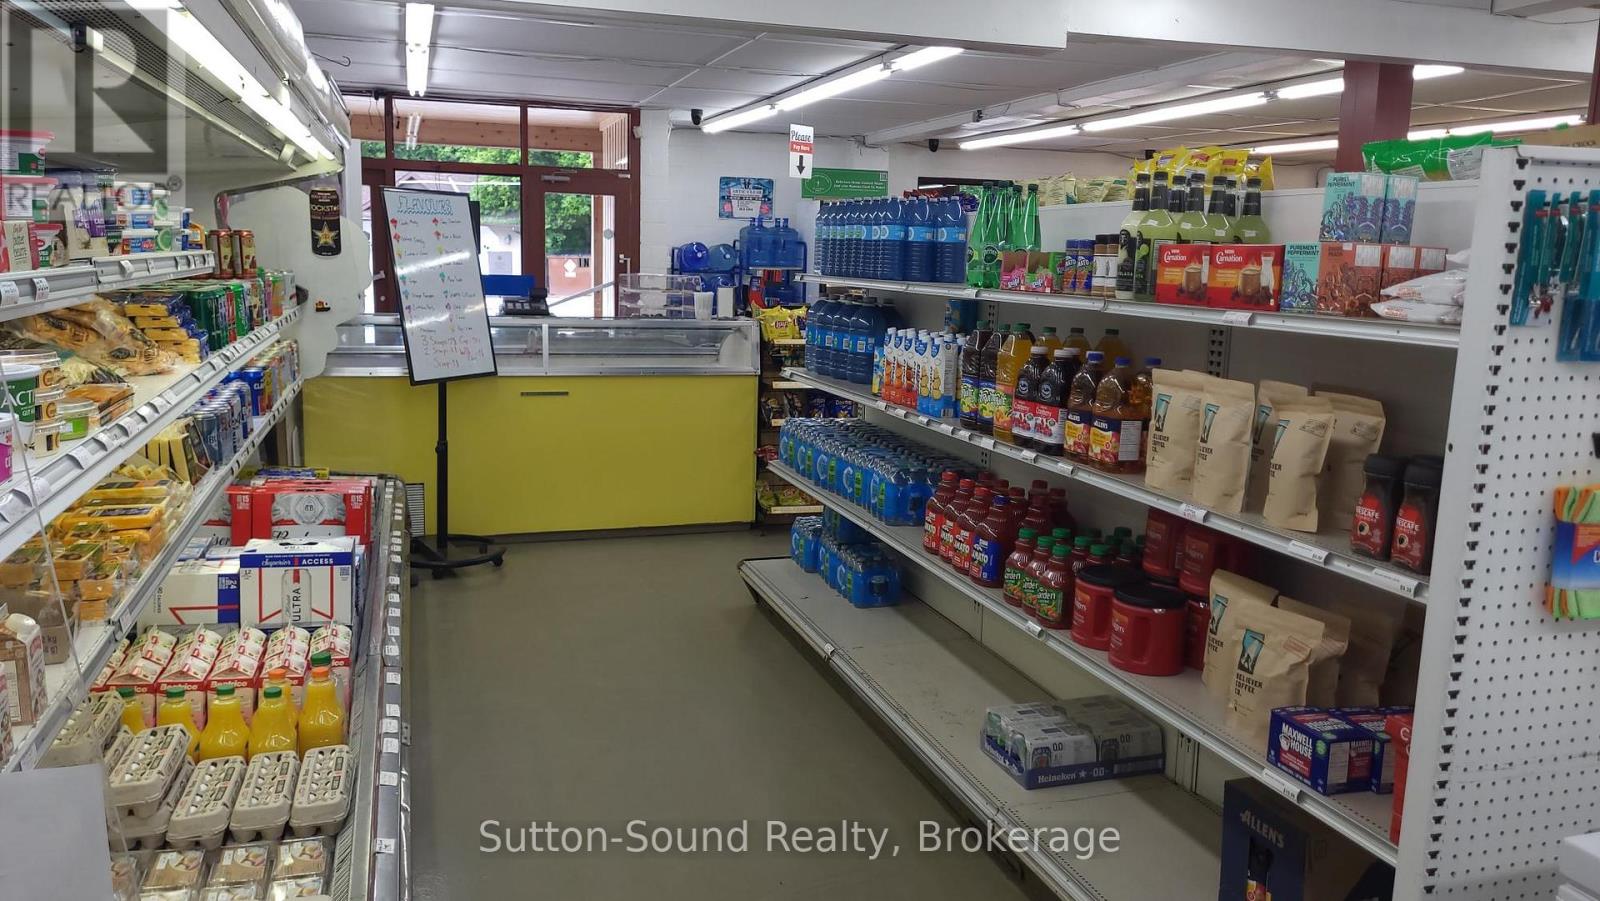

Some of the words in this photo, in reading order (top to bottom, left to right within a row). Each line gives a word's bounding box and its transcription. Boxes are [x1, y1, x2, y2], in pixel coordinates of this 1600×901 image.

[791, 130, 811, 142] Please
[1164, 251, 1187, 263] Carnation
[1216, 251, 1243, 264] Carnation
[292, 587, 302, 622] ULTRA
[1235, 680, 1255, 695] COFFEE
[1281, 722, 1313, 751] MAXWELL
[1290, 739, 1313, 760] HOUSE
[1038, 771, 1076, 783] Heineken
[1240, 809, 1285, 849] ALLEN'S
